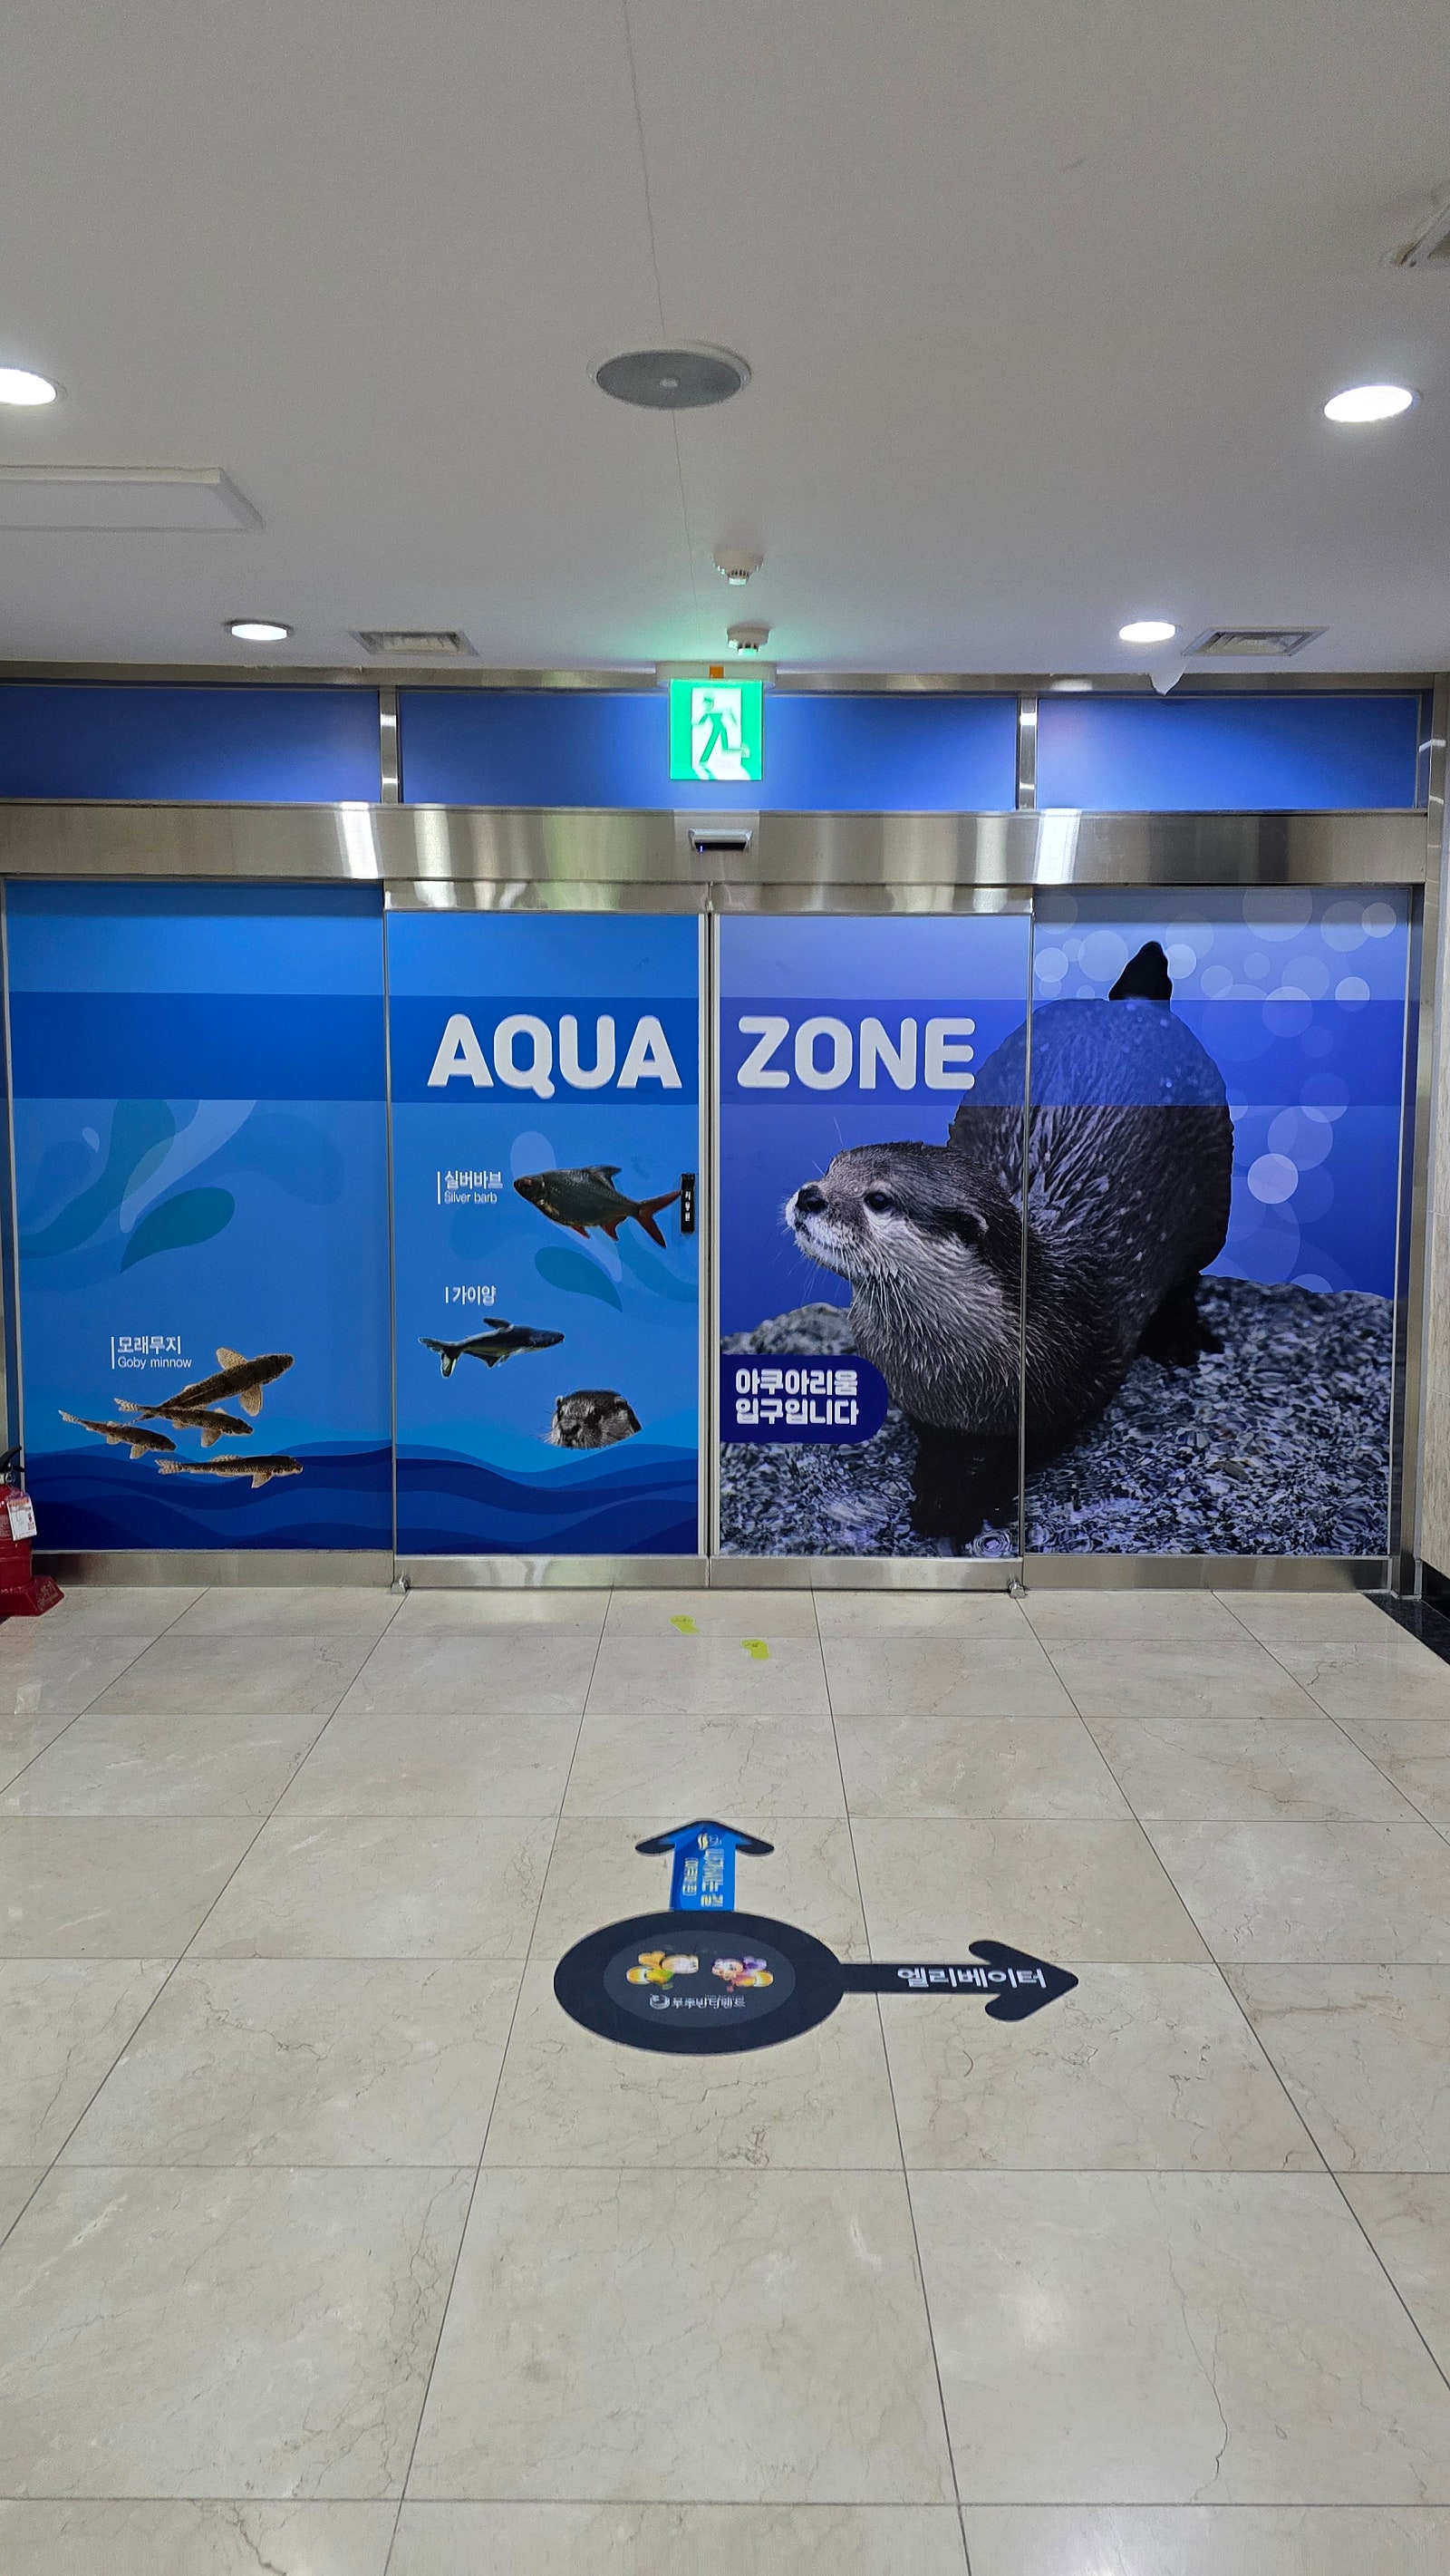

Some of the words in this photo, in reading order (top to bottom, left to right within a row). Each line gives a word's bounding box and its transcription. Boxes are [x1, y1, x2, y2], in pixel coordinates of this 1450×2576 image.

[427, 1013, 682, 1099] AQUA
[737, 1016, 976, 1091] ZONE
[444, 1170, 503, 1190] 실버바브
[444, 1190, 471, 1205] Silver
[474, 1191, 498, 1205] barb
[118, 1335, 181, 1355] 모래무지
[118, 1355, 146, 1370] Goby
[150, 1357, 192, 1369] minnow
[735, 1368, 858, 1396] 아쿠아리움
[735, 1397, 859, 1425] 입구입니다
[897, 1967, 1047, 1989] 엘리베이터
